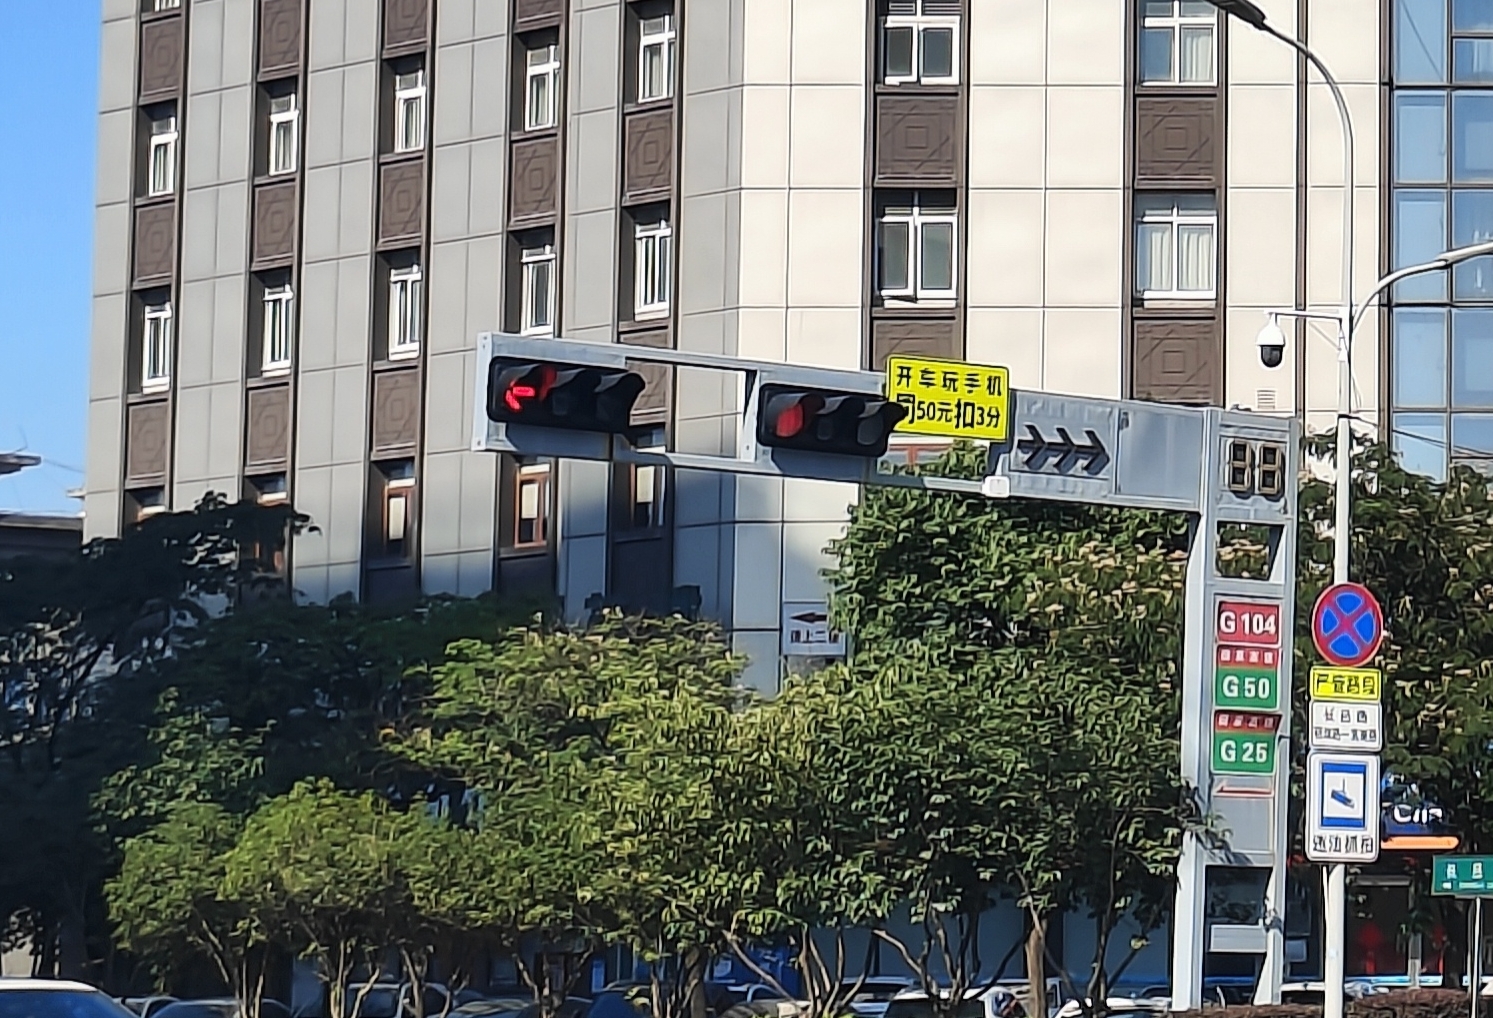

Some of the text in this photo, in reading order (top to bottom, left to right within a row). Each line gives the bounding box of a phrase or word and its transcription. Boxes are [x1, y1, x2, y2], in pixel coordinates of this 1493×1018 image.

[896, 365, 1002, 397] 开车玩手机
